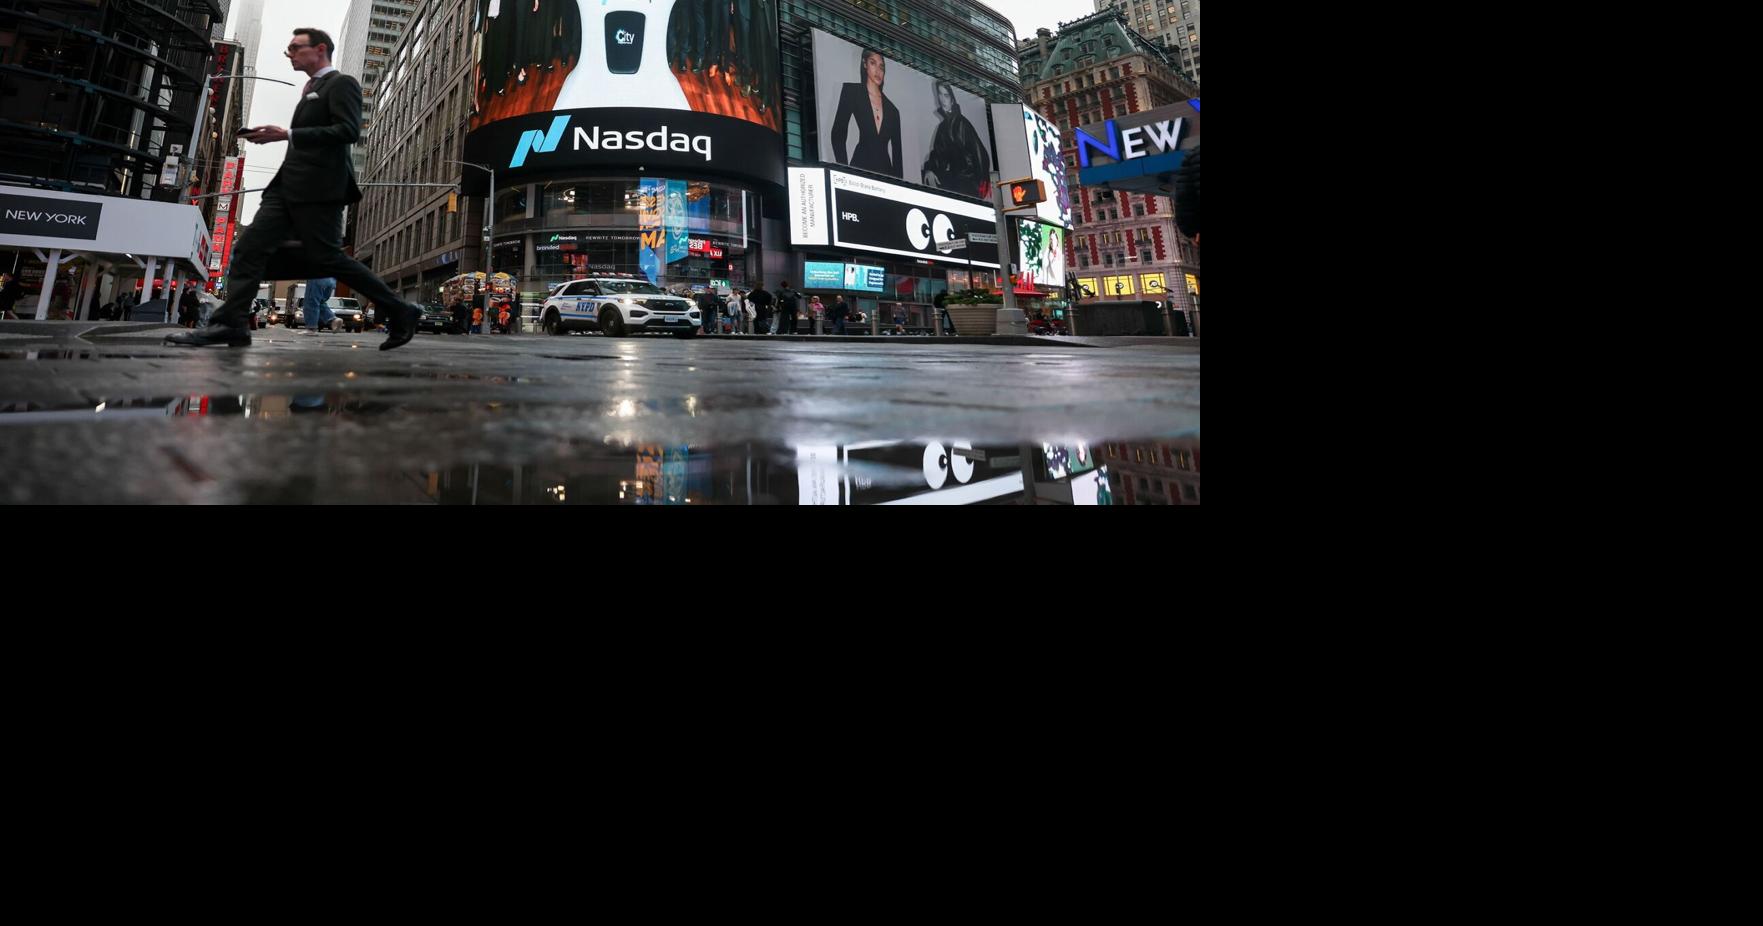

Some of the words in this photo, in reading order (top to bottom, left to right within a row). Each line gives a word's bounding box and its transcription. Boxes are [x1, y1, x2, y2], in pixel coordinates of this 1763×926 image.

[616, 28, 635, 44] City
[573, 125, 712, 161] Nasdaq
[1076, 118, 1186, 167] NEW
[5, 208, 43, 222] NEW
[45, 212, 88, 225] YORK
[842, 211, 860, 222] HPB.
[576, 302, 595, 312] NYPD
